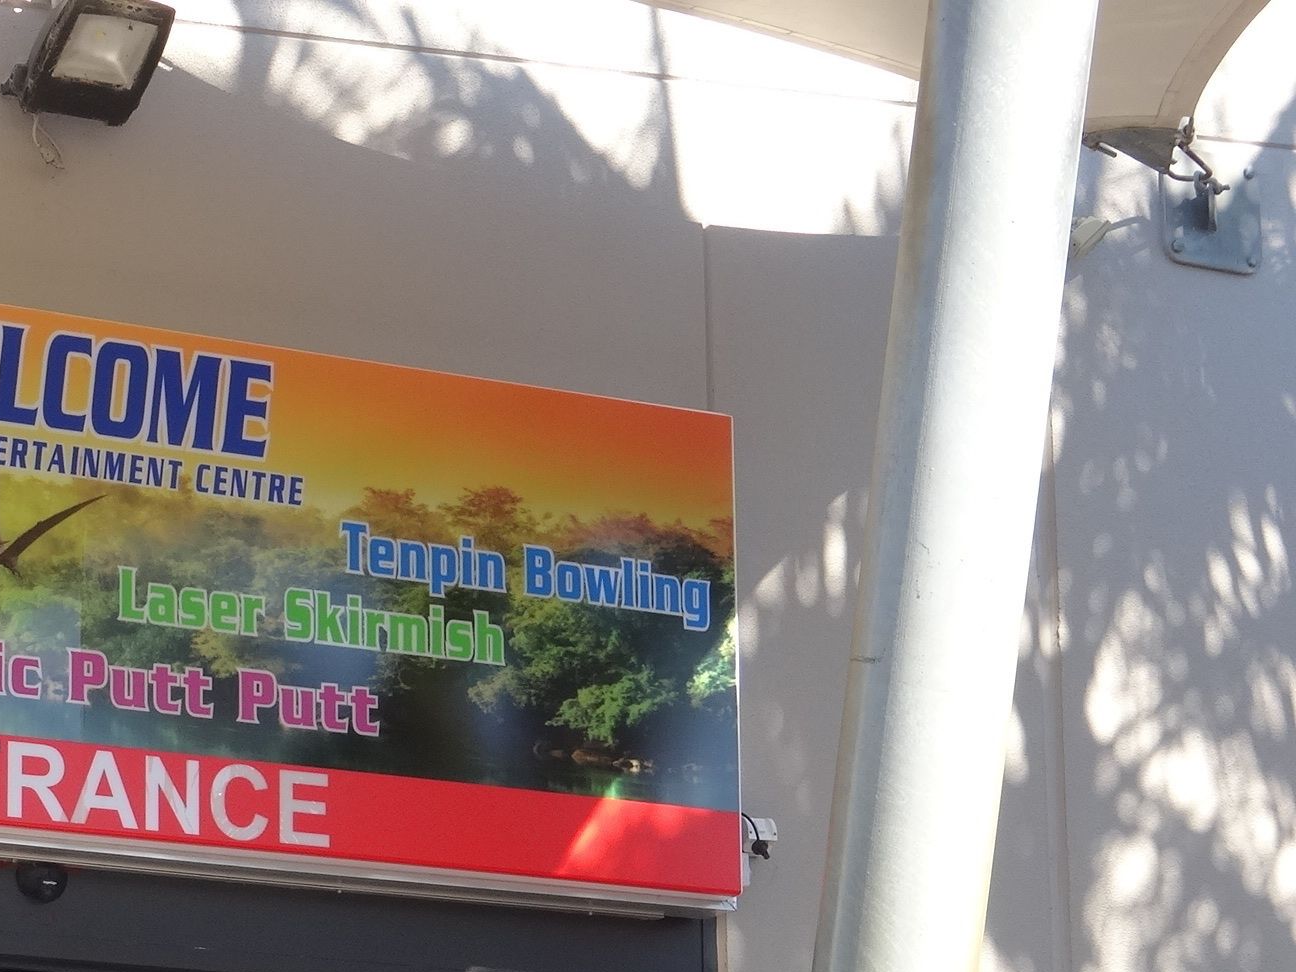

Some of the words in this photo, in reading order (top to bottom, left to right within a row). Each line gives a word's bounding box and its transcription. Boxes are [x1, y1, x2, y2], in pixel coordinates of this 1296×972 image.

[195, 463, 304, 506] CENTRE
[117, 565, 266, 638] Laser
[283, 588, 505, 666] Skirmish
[339, 520, 505, 596] Tenpin
[524, 544, 710, 630] Bowling
[65, 648, 212, 718] Putt
[236, 668, 380, 737] Putt
